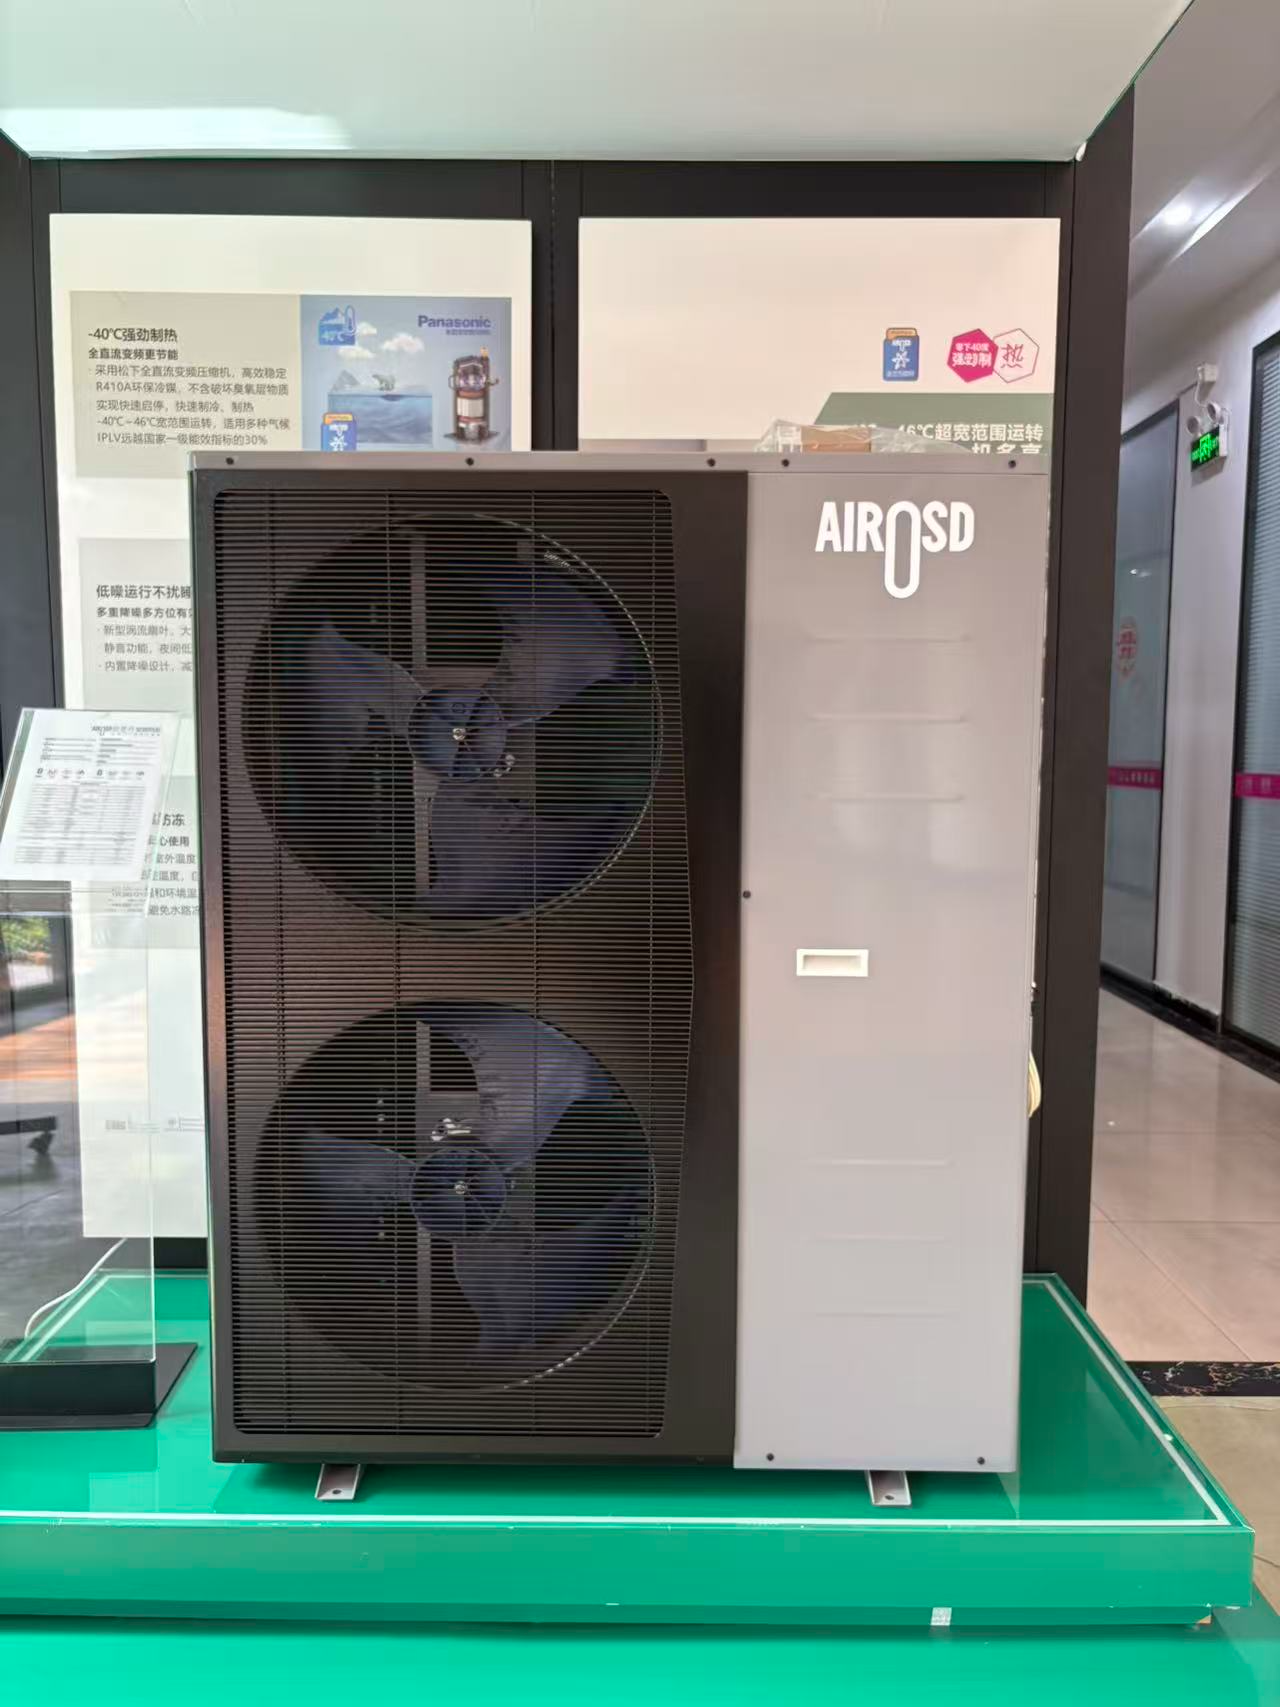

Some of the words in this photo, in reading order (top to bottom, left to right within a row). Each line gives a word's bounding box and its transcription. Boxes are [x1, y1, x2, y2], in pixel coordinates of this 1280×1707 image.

[418, 315, 491, 328] Panasonic
[88, 348, 178, 361] 全直流变频更节能
[815, 500, 975, 599] AIROSD
